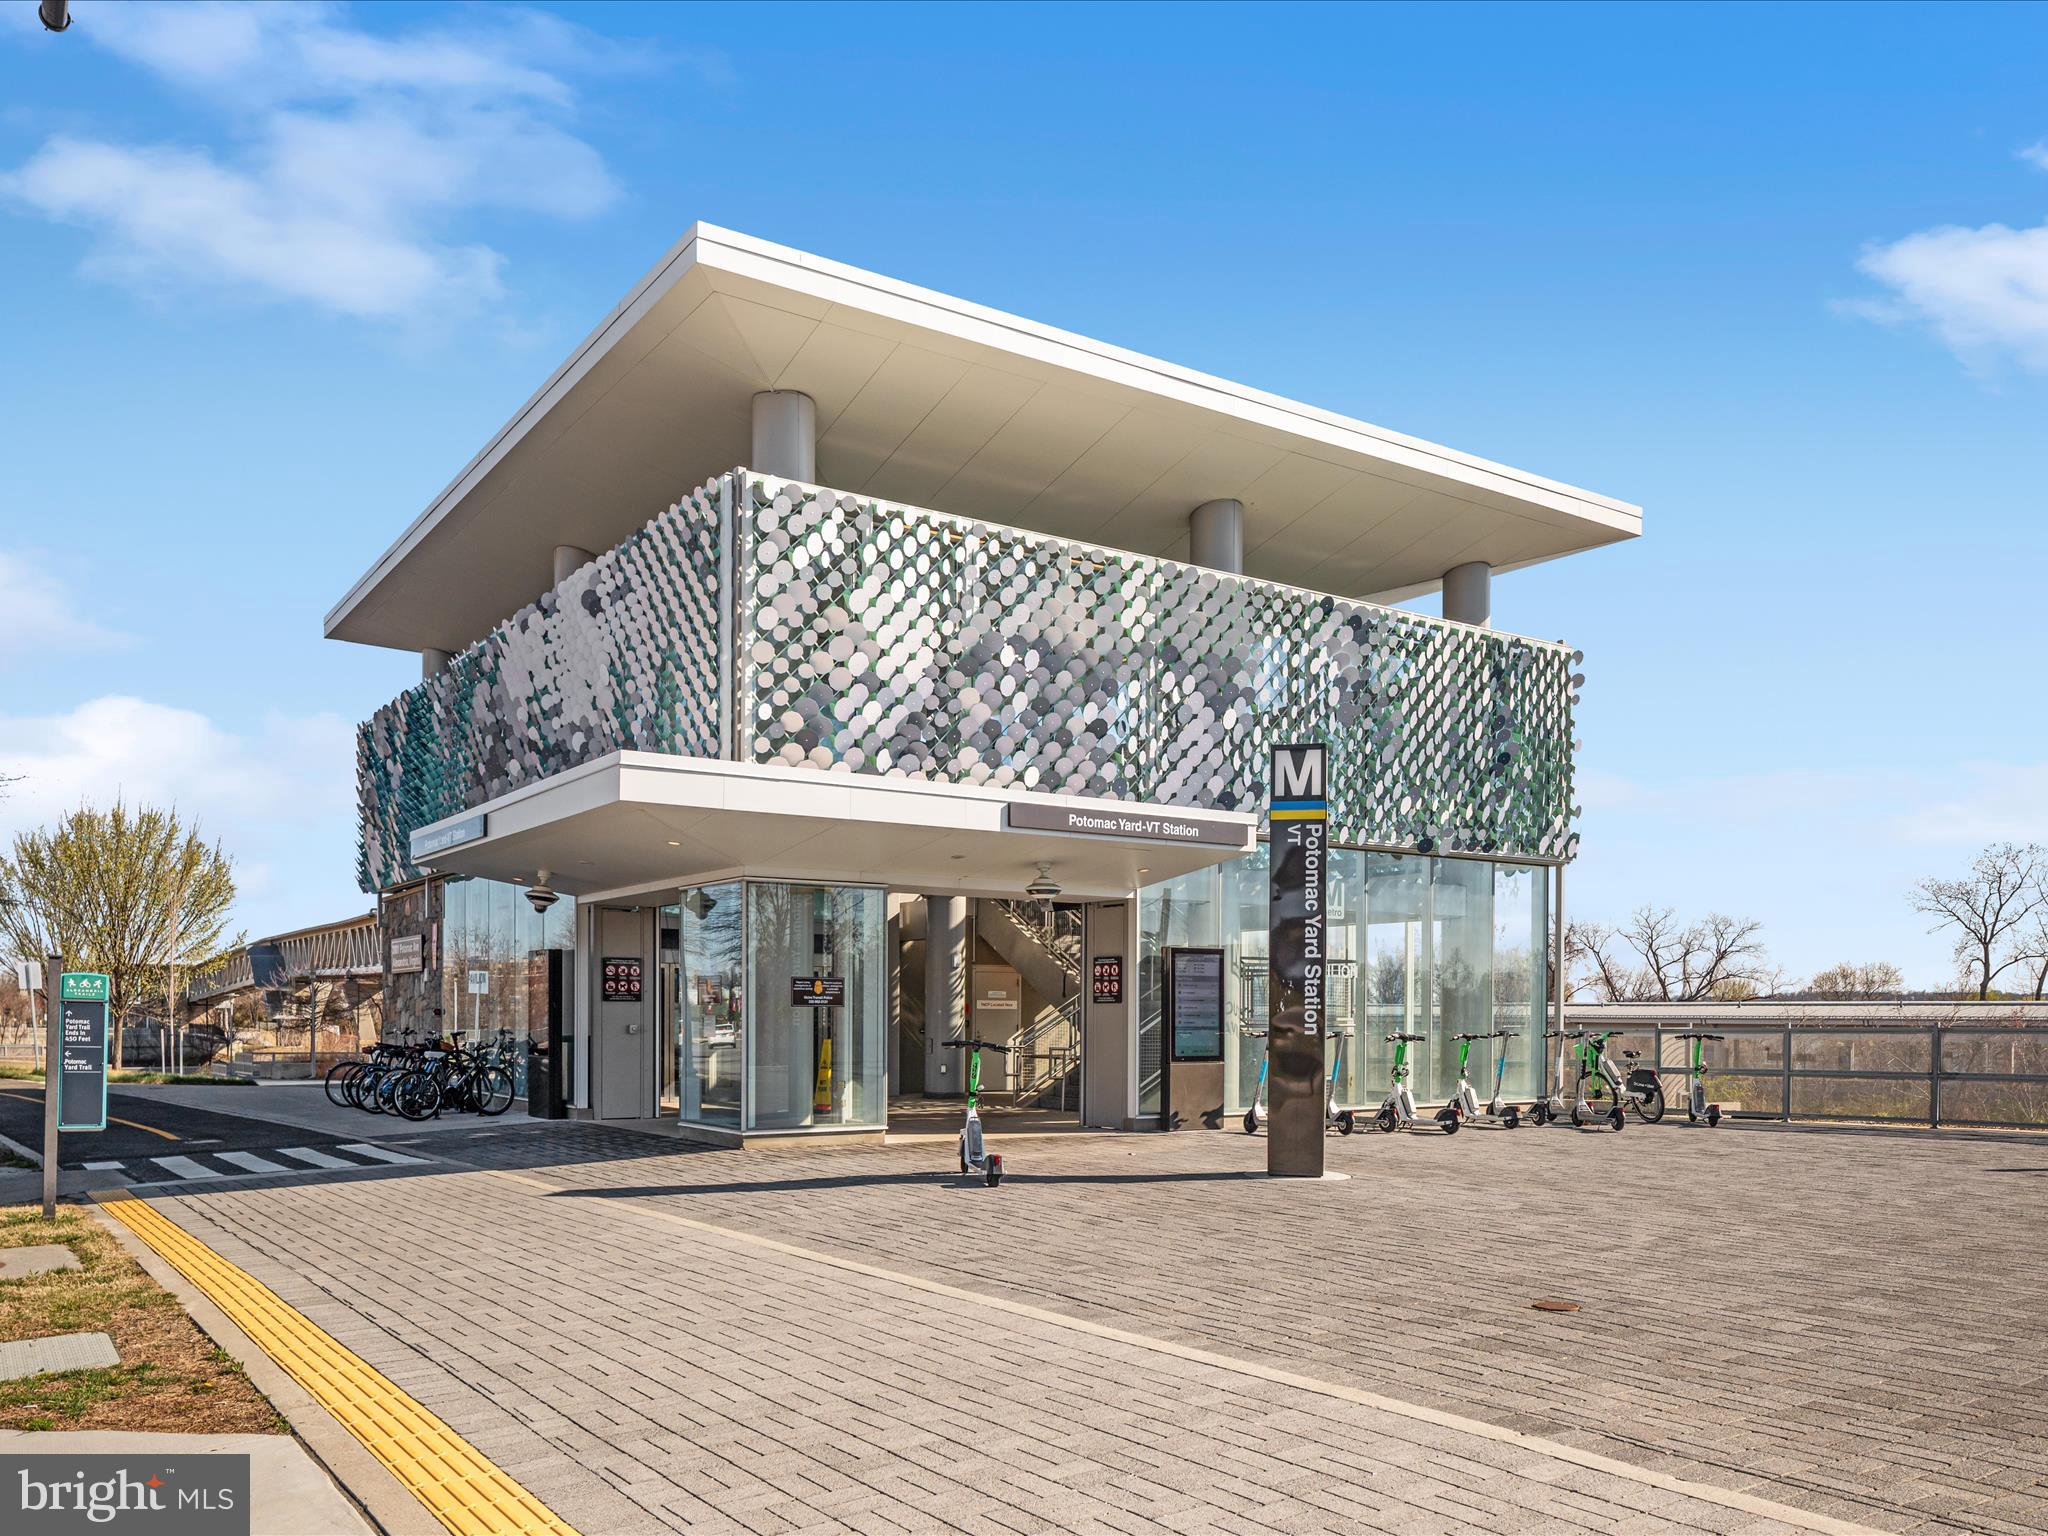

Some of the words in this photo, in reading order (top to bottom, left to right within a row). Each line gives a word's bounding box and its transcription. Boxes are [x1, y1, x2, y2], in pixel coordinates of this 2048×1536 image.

[1274, 749, 1322, 796] M
[1069, 813, 1117, 830] Potomac
[1118, 817, 1161, 834] Yard-VT
[1162, 822, 1199, 837] Station
[1287, 824, 1302, 846] VT
[1305, 823, 1323, 911] Potomac
[1326, 908, 1343, 917] etro
[1304, 914, 1322, 958] Yard
[1304, 964, 1322, 1036] Station
